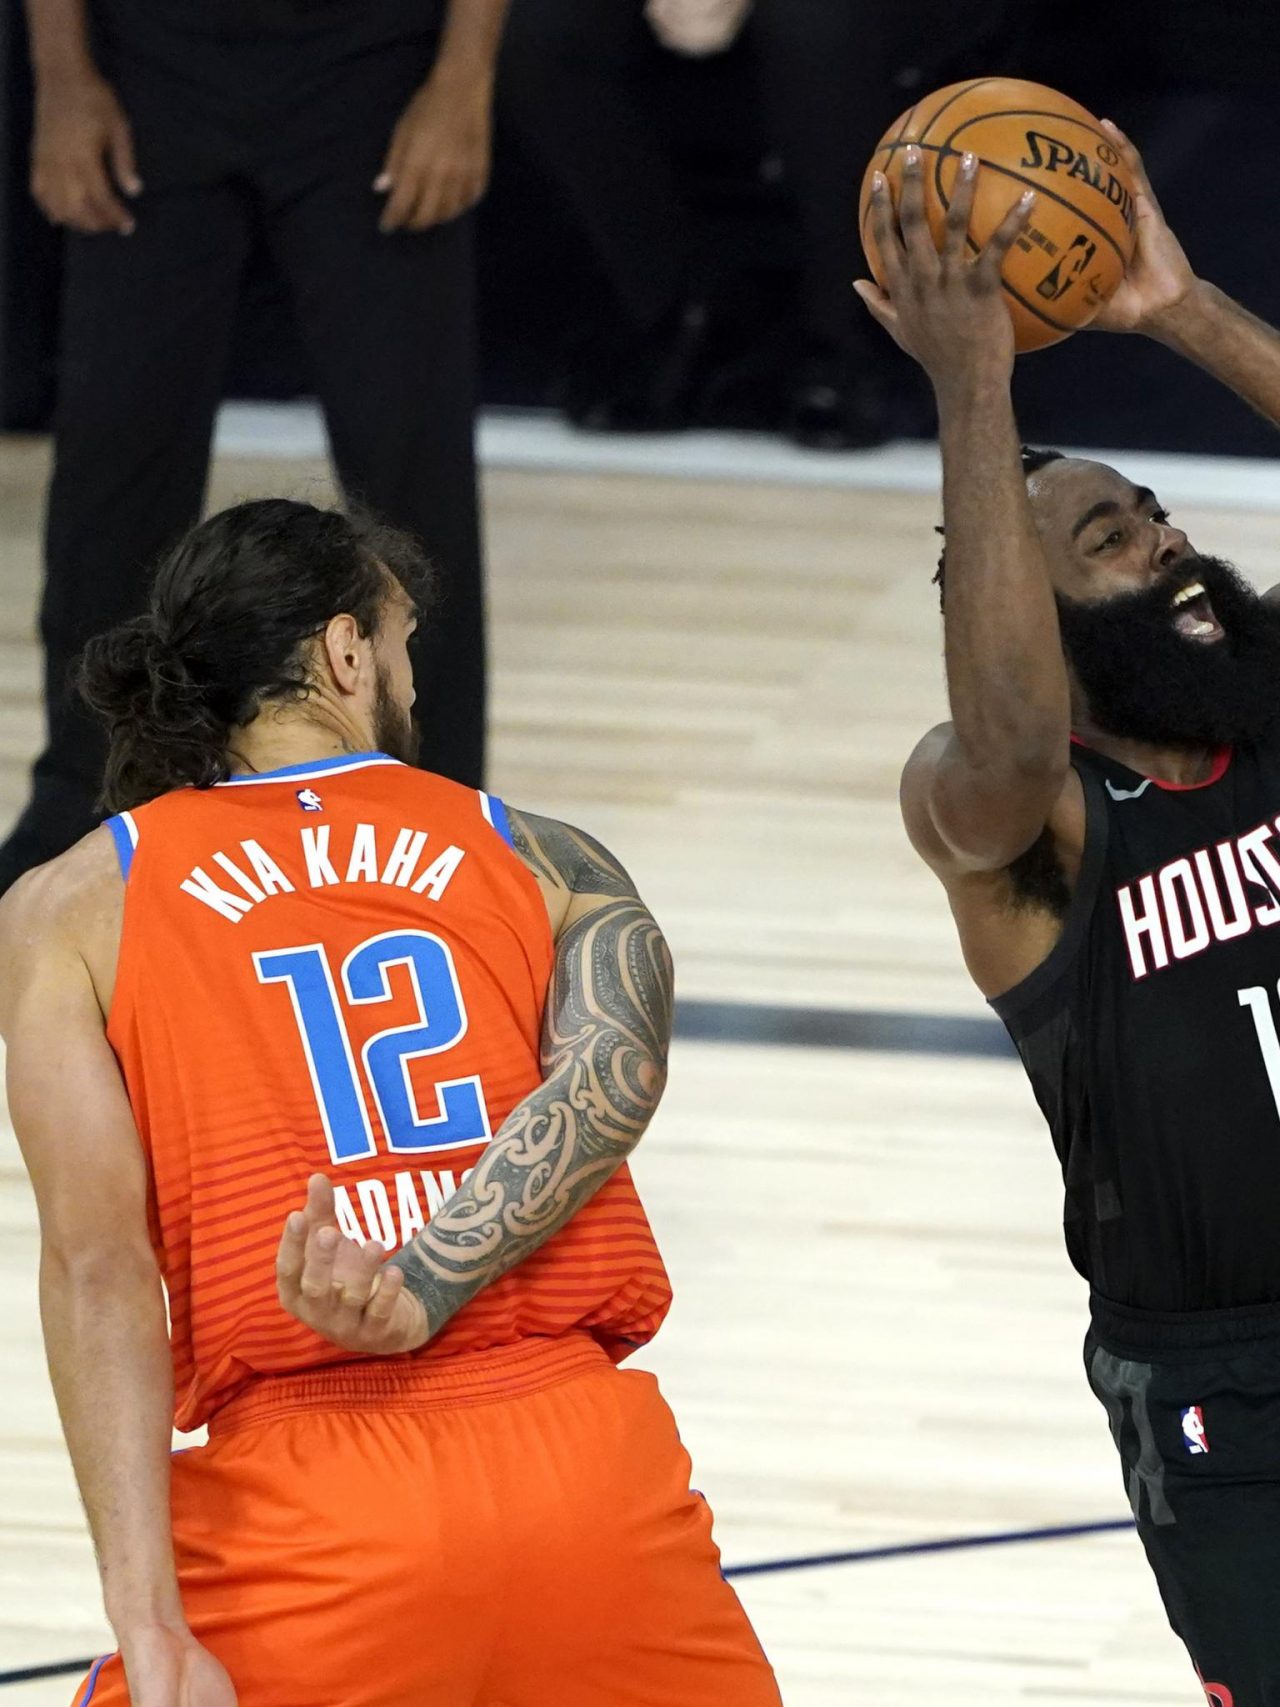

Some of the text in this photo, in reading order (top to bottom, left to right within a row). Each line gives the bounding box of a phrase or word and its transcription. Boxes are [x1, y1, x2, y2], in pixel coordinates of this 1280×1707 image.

[180, 824, 466, 923] KIA KAHA
[251, 929, 492, 1165] 12
